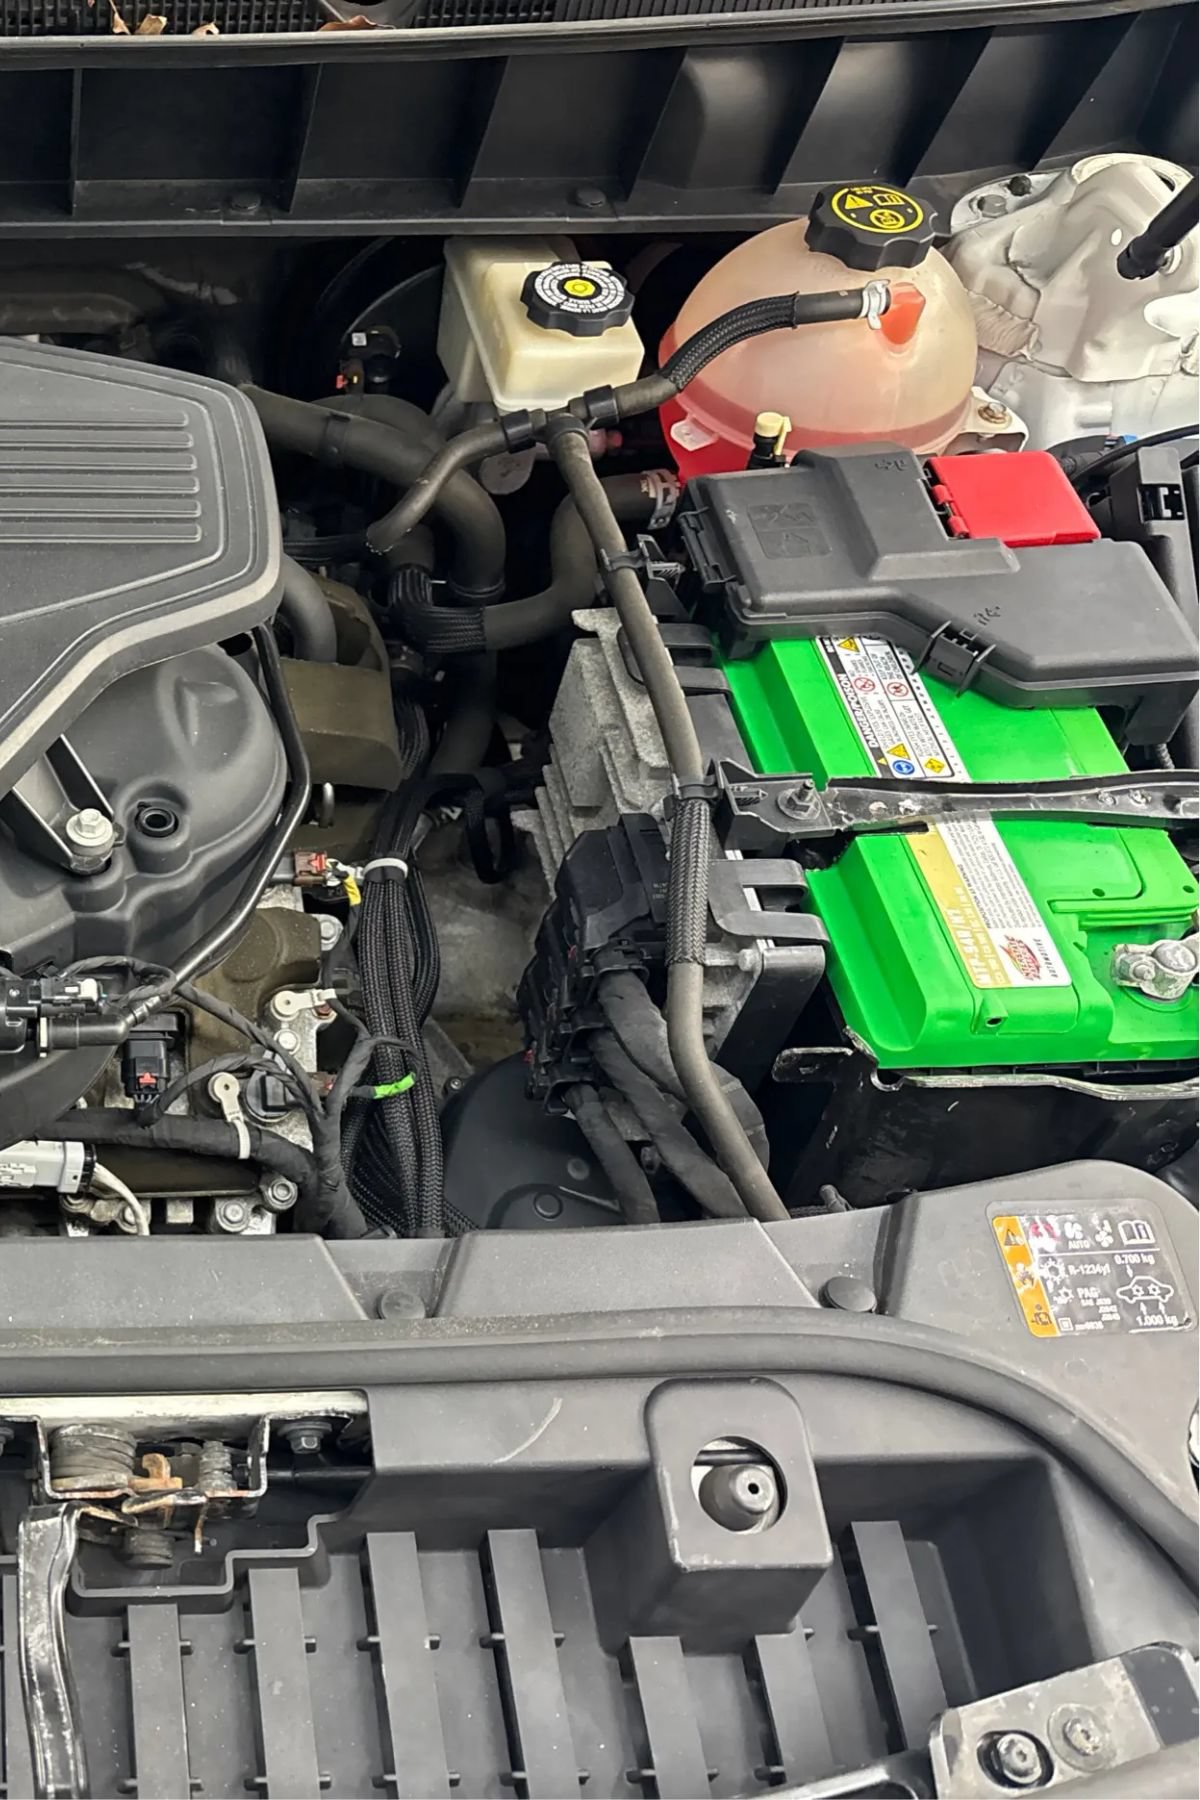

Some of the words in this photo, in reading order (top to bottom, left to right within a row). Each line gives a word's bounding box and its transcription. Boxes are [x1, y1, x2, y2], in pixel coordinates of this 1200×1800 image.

[836, 673, 879, 748] DANGER/POISON
[1004, 934, 1033, 980] INTERSTATE
[1032, 938, 1059, 977] AUTOMOTIVE
[1068, 1240, 1091, 1250] AUTO
[1114, 1254, 1140, 1265] 0.700
[1142, 1253, 1156, 1266] kg
[1136, 1314, 1165, 1327] 1.000
[1166, 1314, 1179, 1328] kg
